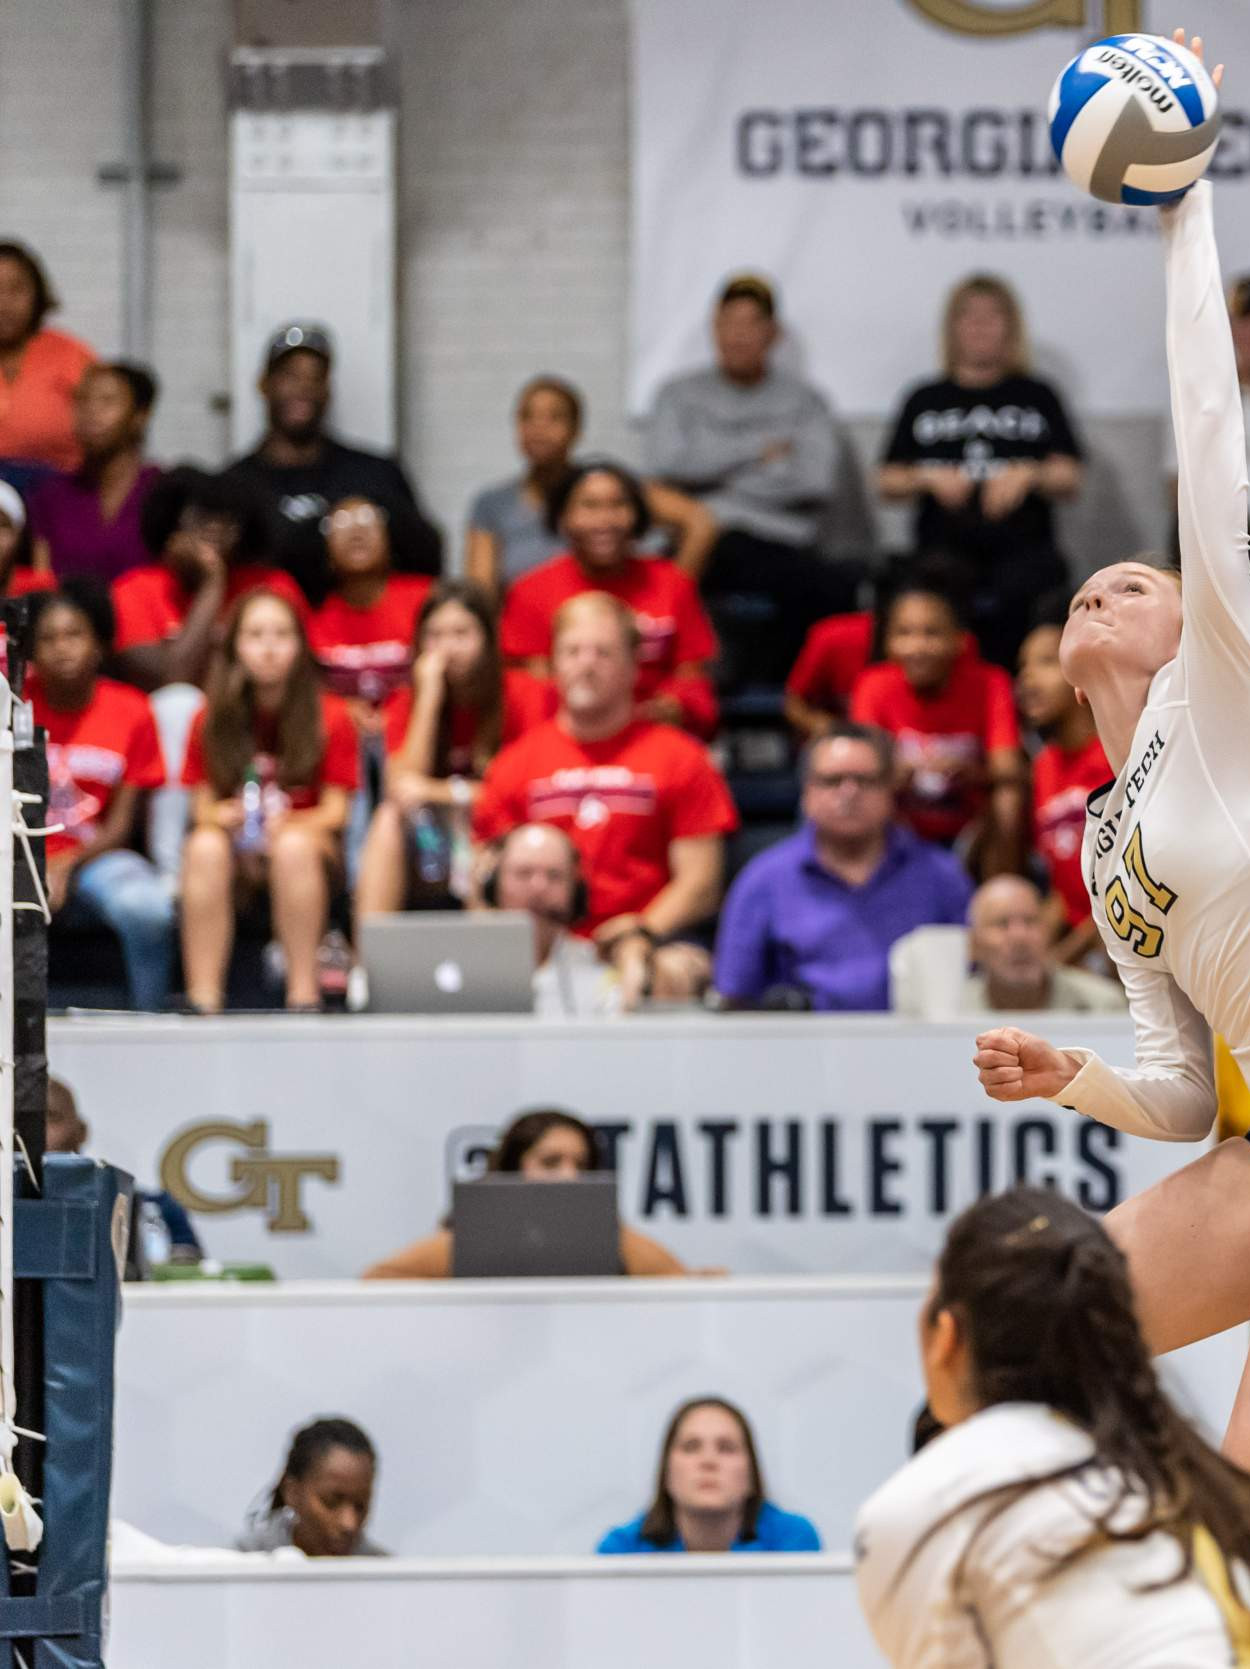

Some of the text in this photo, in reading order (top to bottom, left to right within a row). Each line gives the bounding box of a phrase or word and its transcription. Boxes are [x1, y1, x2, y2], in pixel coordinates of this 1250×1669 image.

[1097, 50, 1175, 113] molten
[736, 107, 1062, 180] GEORGI
[1104, 820, 1179, 958] 97
[159, 1118, 340, 1234] GT
